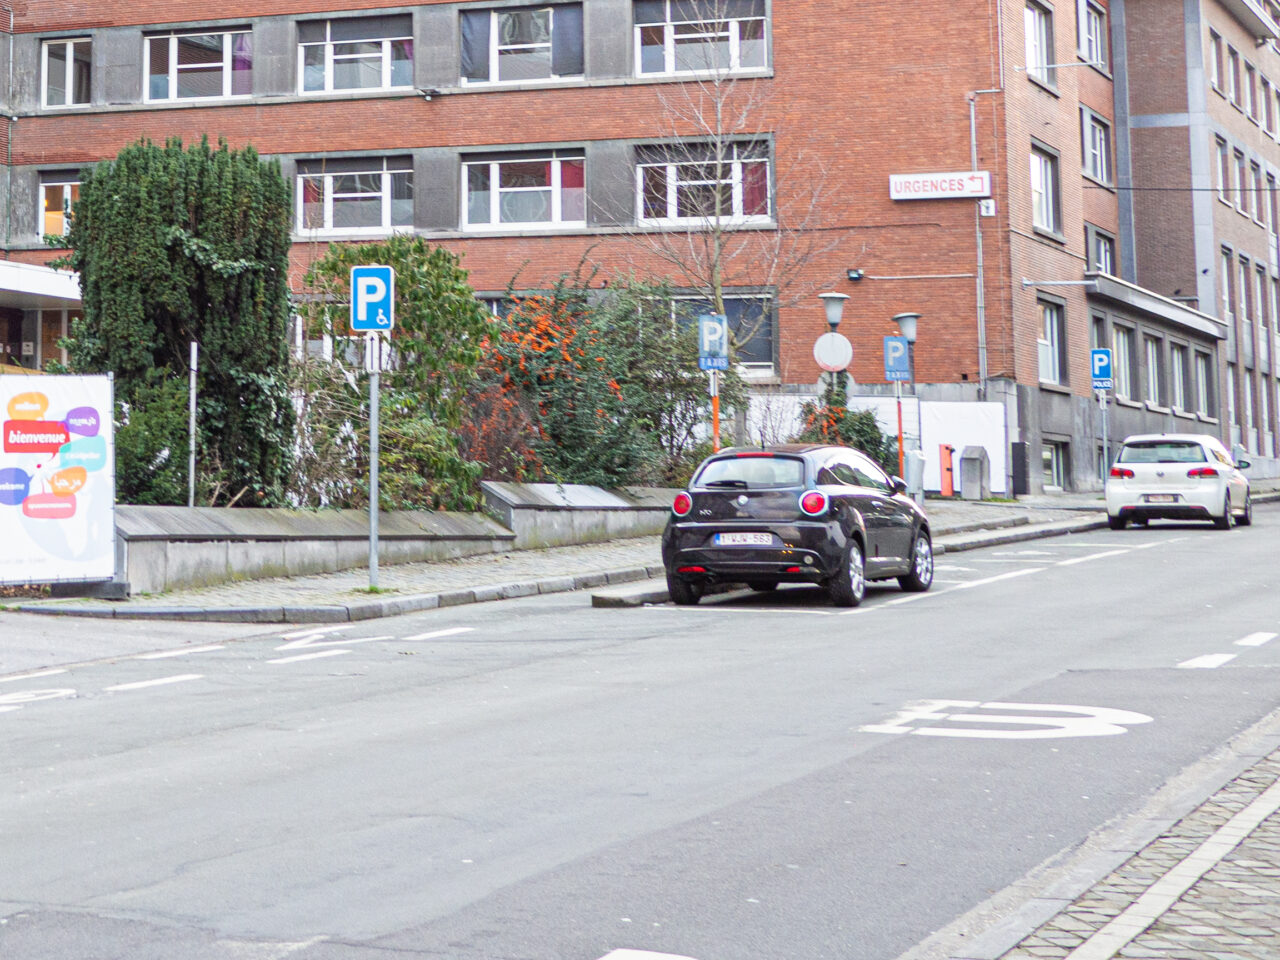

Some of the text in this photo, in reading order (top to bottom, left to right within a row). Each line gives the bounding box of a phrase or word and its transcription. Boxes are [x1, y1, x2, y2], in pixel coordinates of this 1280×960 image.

[893, 178, 965, 194] URGENCES
[357, 276, 387, 322] P
[703, 321, 723, 352] P
[887, 341, 905, 367] P
[1093, 353, 1109, 375] P
[8, 430, 66, 444] bienvenue
